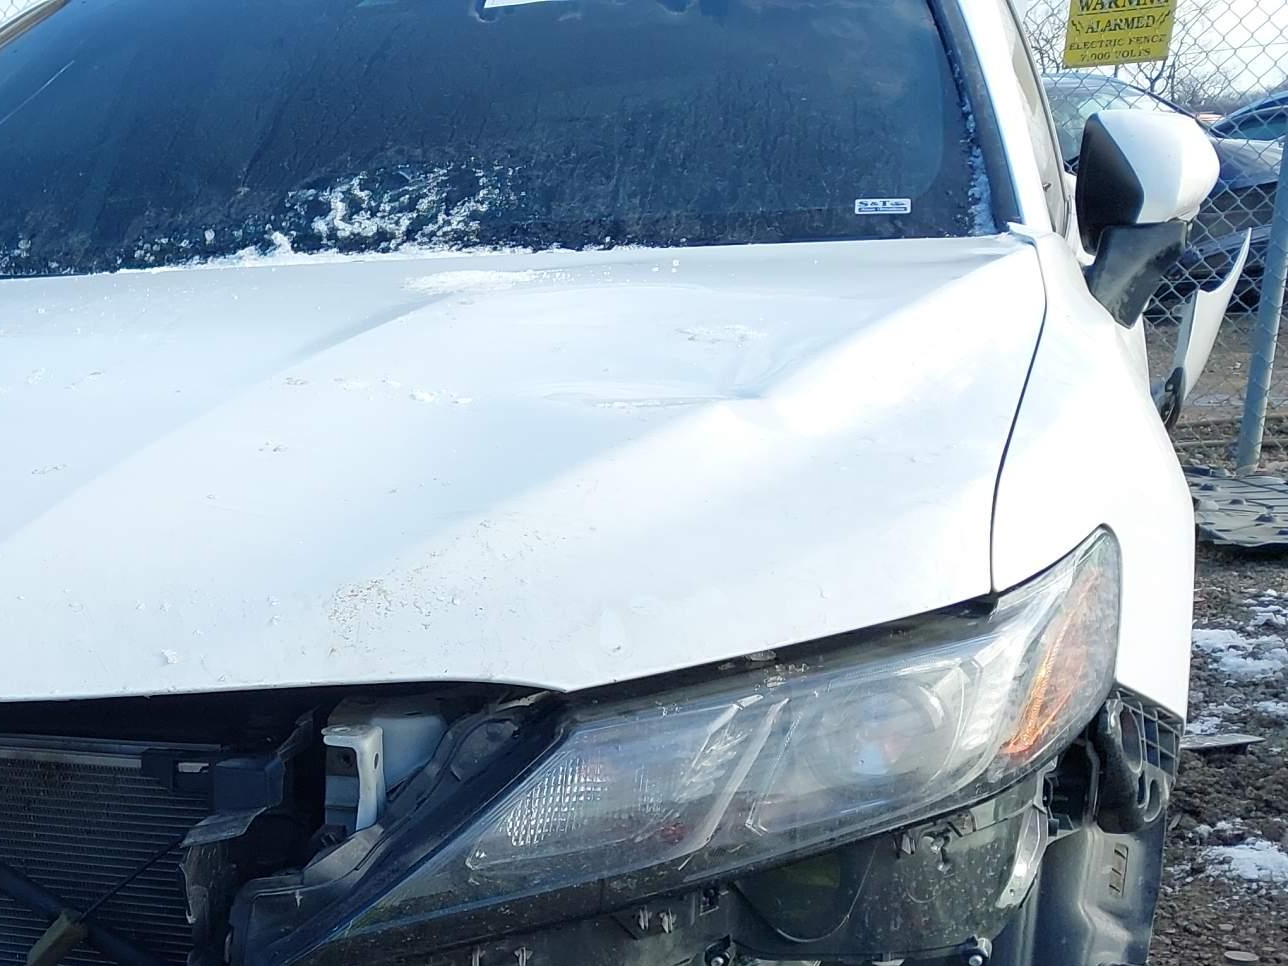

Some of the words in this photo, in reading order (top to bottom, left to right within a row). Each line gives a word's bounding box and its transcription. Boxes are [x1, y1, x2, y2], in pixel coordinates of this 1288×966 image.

[1079, 0, 1169, 12] WARN
[1086, 15, 1156, 34] ALARMED
[1070, 40, 1124, 51] ELECTRIC
